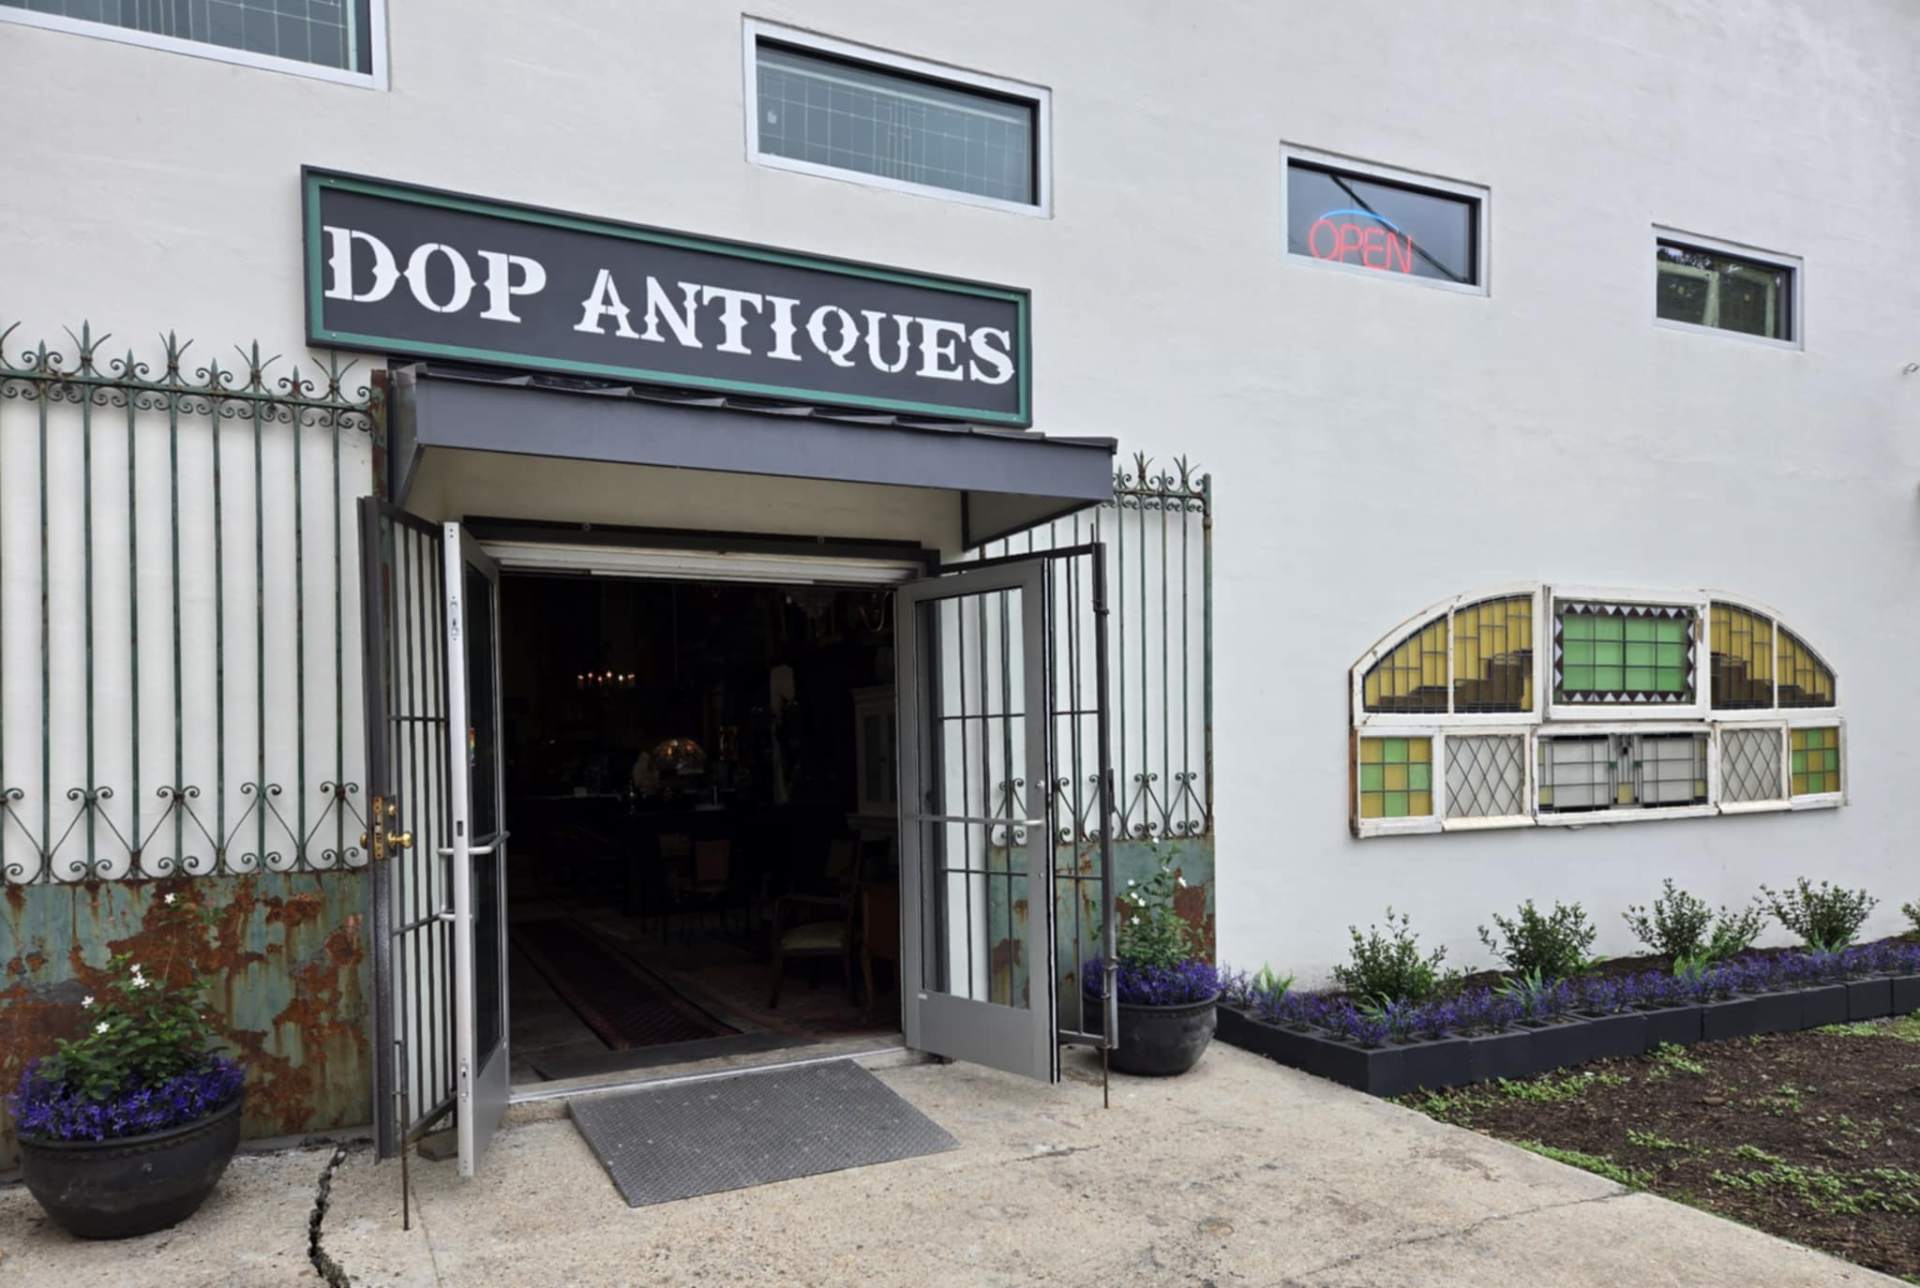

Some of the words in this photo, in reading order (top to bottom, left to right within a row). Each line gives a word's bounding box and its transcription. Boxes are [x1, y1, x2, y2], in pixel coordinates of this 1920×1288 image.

[1308, 218, 1414, 274] OPEN
[322, 225, 547, 323] DOP
[573, 268, 1016, 386] ANTIQUES
